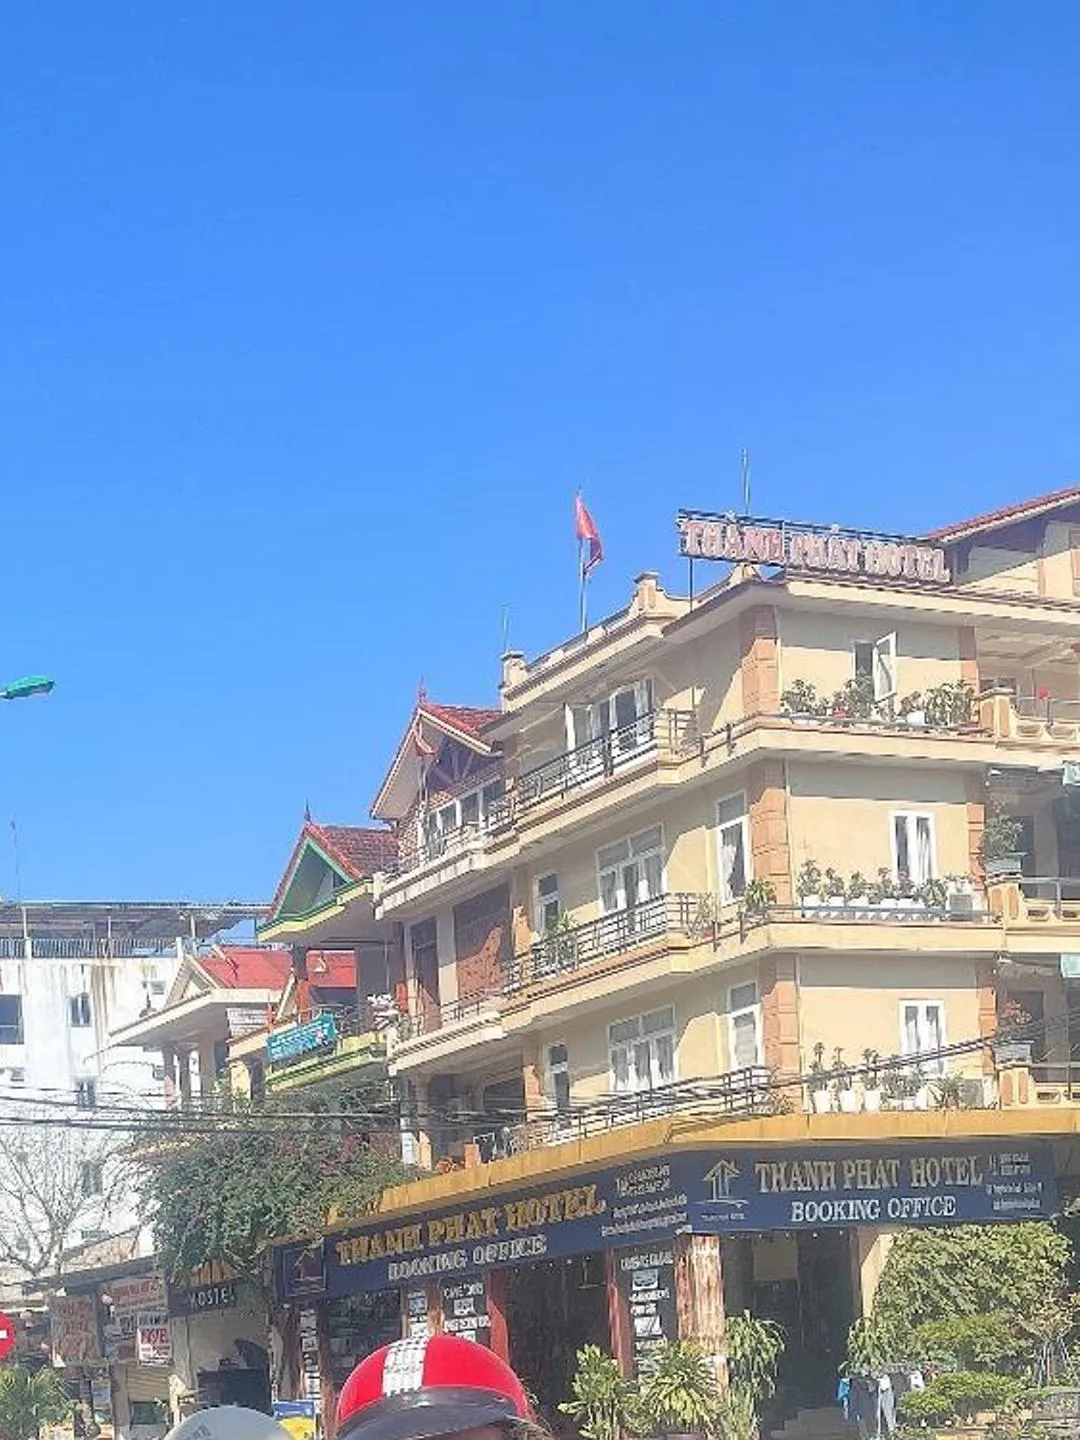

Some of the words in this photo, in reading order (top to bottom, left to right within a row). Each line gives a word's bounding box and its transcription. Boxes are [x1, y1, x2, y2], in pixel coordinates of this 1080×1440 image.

[864, 539, 951, 583] HOTEL
[755, 1159, 837, 1193] THANH
[842, 1158, 901, 1190] PHAT
[908, 1154, 984, 1188] HOTEL
[335, 1226, 422, 1266] THANH
[427, 1206, 499, 1246] PHAT
[505, 1183, 606, 1231] HOTEL
[791, 1200, 881, 1223] BOOKING
[886, 1195, 957, 1219] OFFICE
[387, 1248, 468, 1281] BOOKING
[472, 1233, 548, 1267] OFFICE
